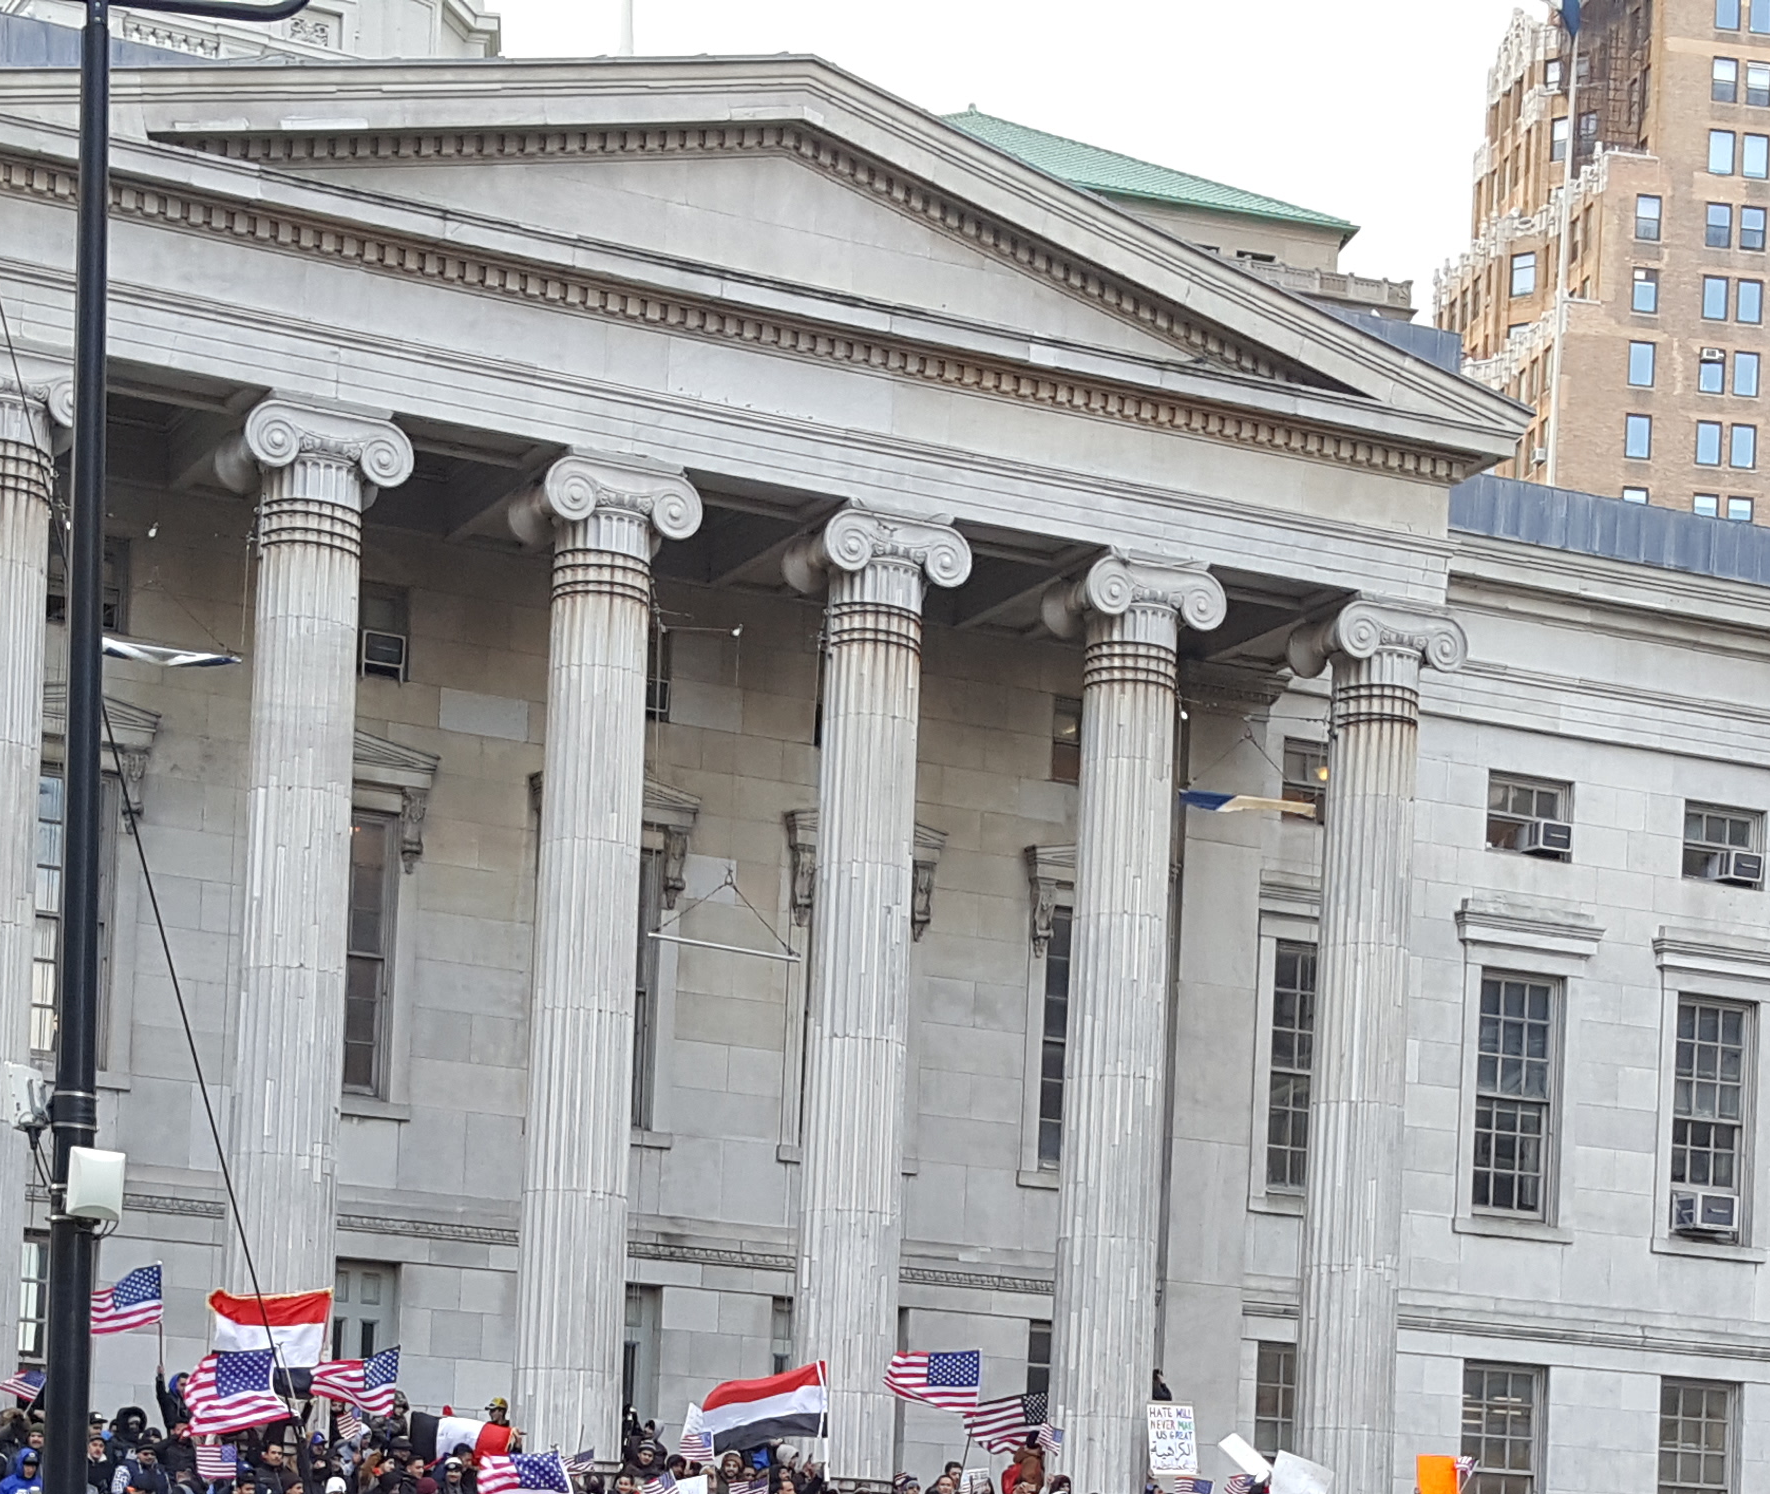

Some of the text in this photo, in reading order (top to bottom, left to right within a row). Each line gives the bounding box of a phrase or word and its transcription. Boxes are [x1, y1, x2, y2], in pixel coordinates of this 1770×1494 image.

[1149, 1406, 1172, 1418] HATE
[1150, 1420, 1175, 1430] NEVER
[1156, 1431, 1193, 1440] US GREAT
